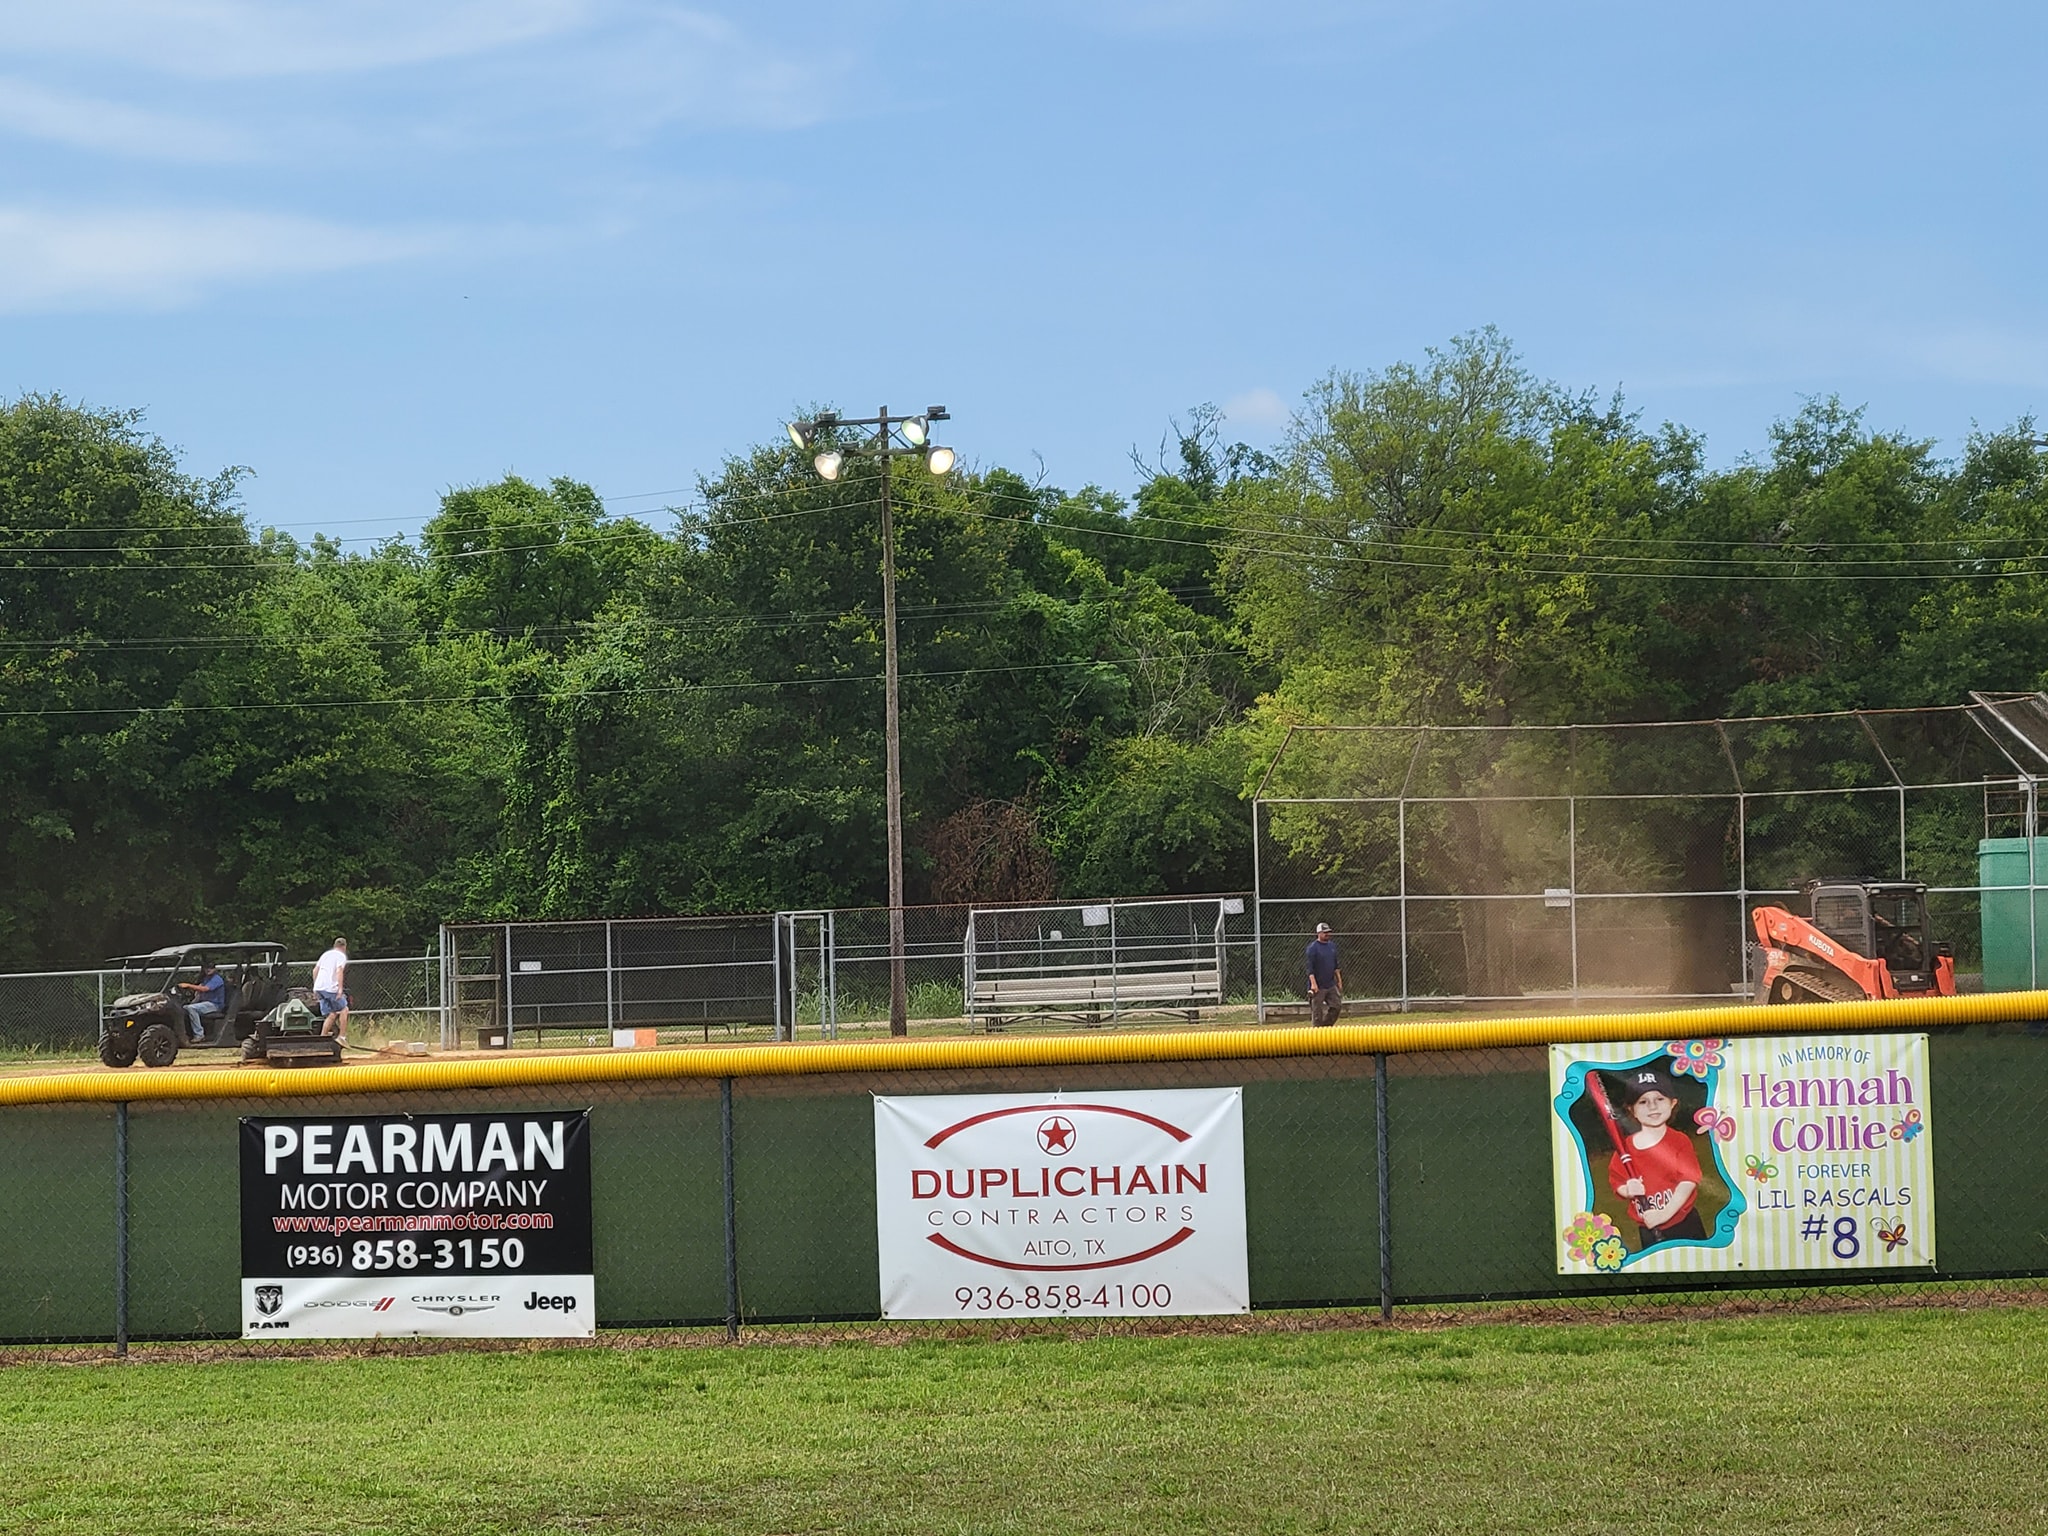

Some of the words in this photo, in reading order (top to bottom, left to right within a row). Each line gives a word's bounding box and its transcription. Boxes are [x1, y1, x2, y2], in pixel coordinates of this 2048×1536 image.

[1808, 933, 1835, 957] KUBOTA
[1778, 1052, 1793, 1067] IN
[1795, 1046, 1852, 1063] MEMORY
[1853, 1049, 1871, 1064] OF
[1742, 1069, 1914, 1108] Hannah
[1772, 1115, 1887, 1152] Collie
[264, 1121, 565, 1174] PEARMAN
[911, 1164, 1208, 1199] DUPLICHAIN
[1798, 1163, 1871, 1178] FOREVER
[281, 1183, 388, 1210] MOTOR
[396, 1180, 547, 1208] COMPANY
[1758, 1190, 1795, 1209] LIL
[1804, 1187, 1911, 1207] RASCALS
[273, 1212, 553, 1236] www.pearmanmotor.com
[928, 1205, 1193, 1226] CONTRACTORS
[1801, 1214, 1860, 1259] #8
[286, 1244, 343, 1268] (936)
[352, 1238, 525, 1271] 858-3150
[1024, 1240, 1077, 1259] ALTO,
[1084, 1239, 1105, 1255] TX
[304, 1300, 384, 1308] DODGE
[411, 1295, 500, 1303] CHRYSLER
[524, 1292, 576, 1313] Jeep
[955, 1284, 1171, 1311] 936-858-4100
[250, 1321, 289, 1329] RAM
